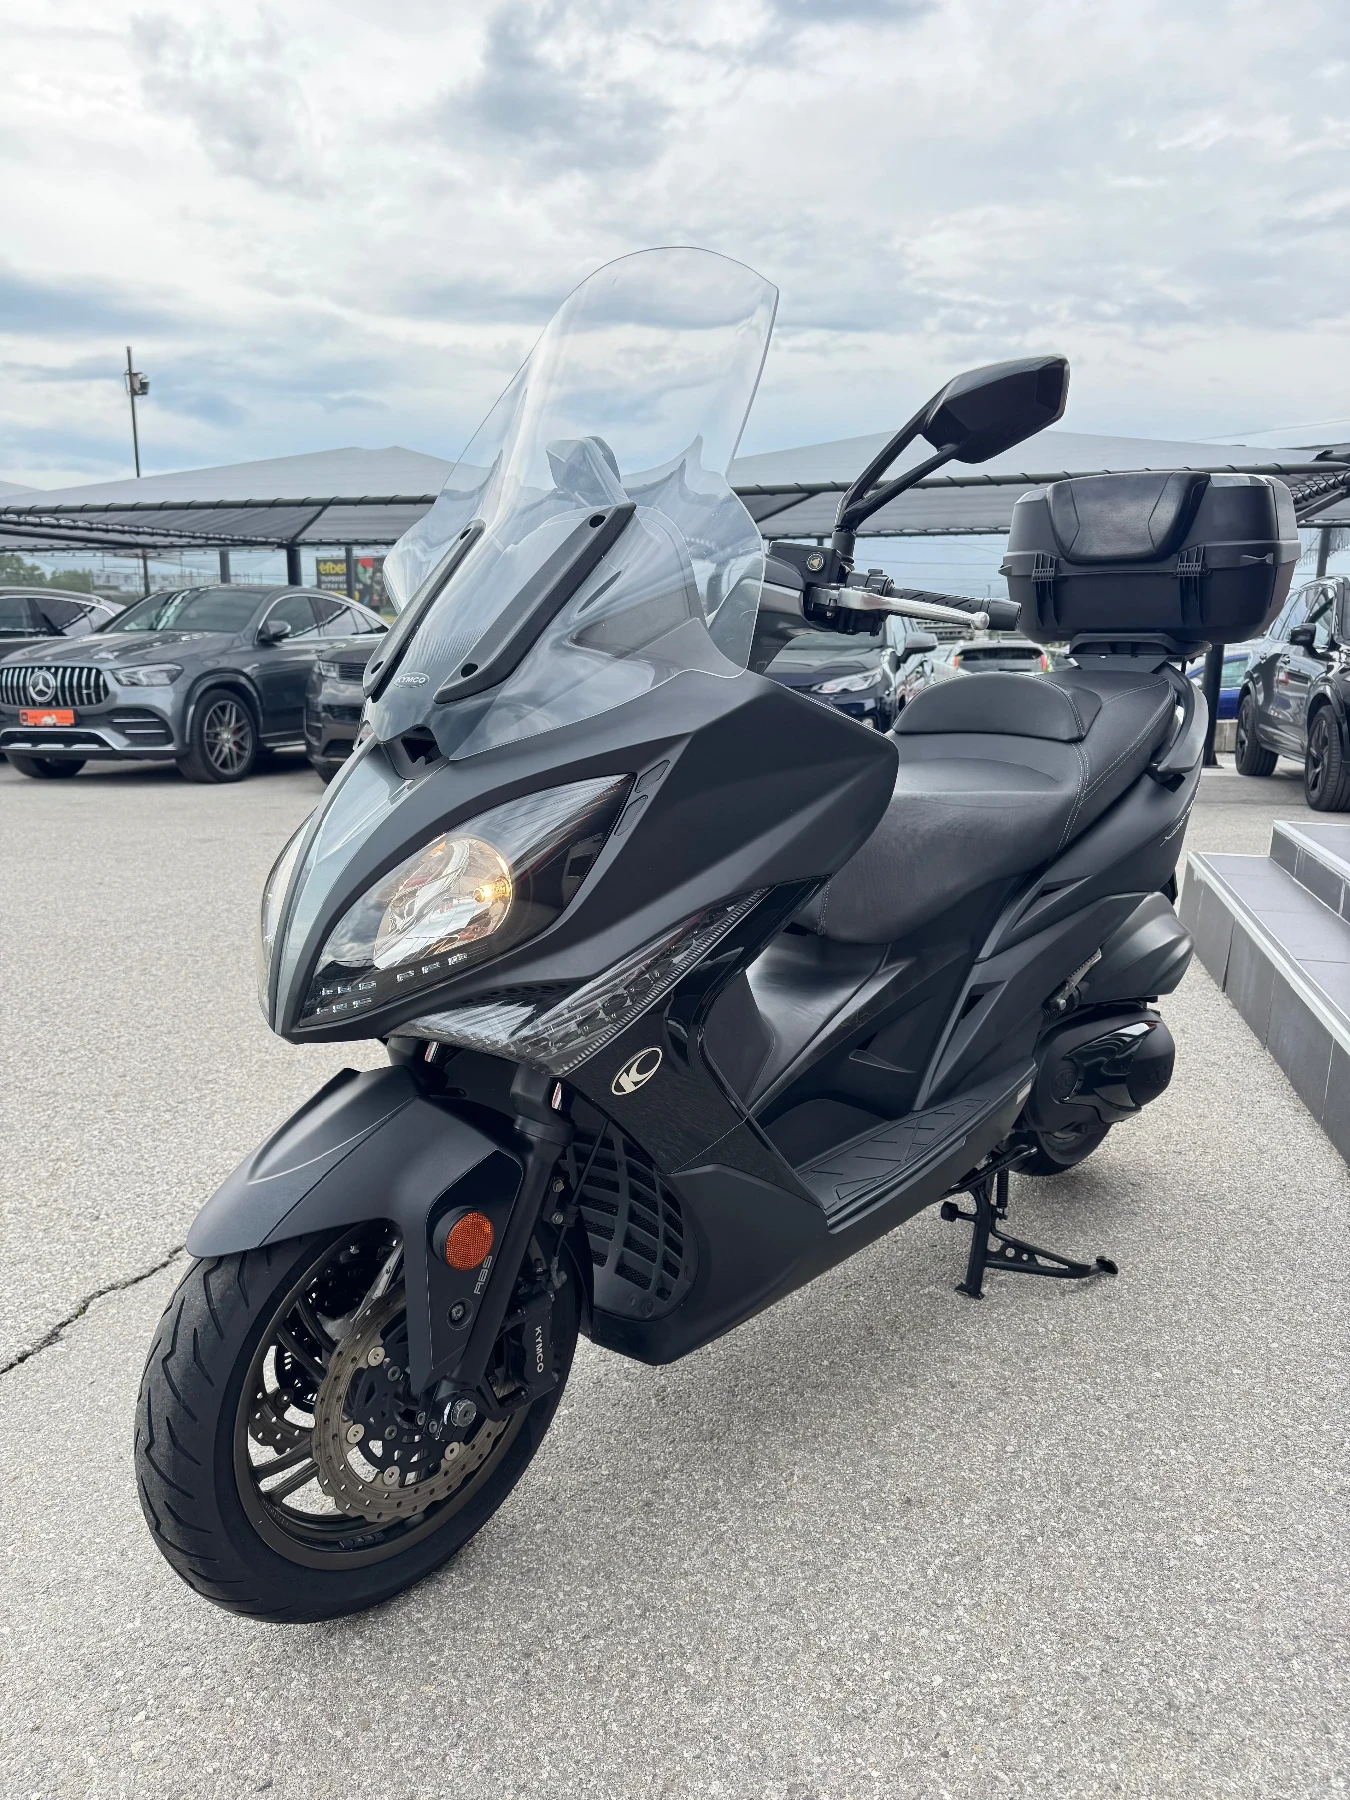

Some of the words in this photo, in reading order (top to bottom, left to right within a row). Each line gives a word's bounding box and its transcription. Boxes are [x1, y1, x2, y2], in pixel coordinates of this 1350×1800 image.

[395, 676, 426, 684] KYMCO
[473, 1255, 493, 1294] ABS
[535, 1325, 544, 1373] KYMCO
